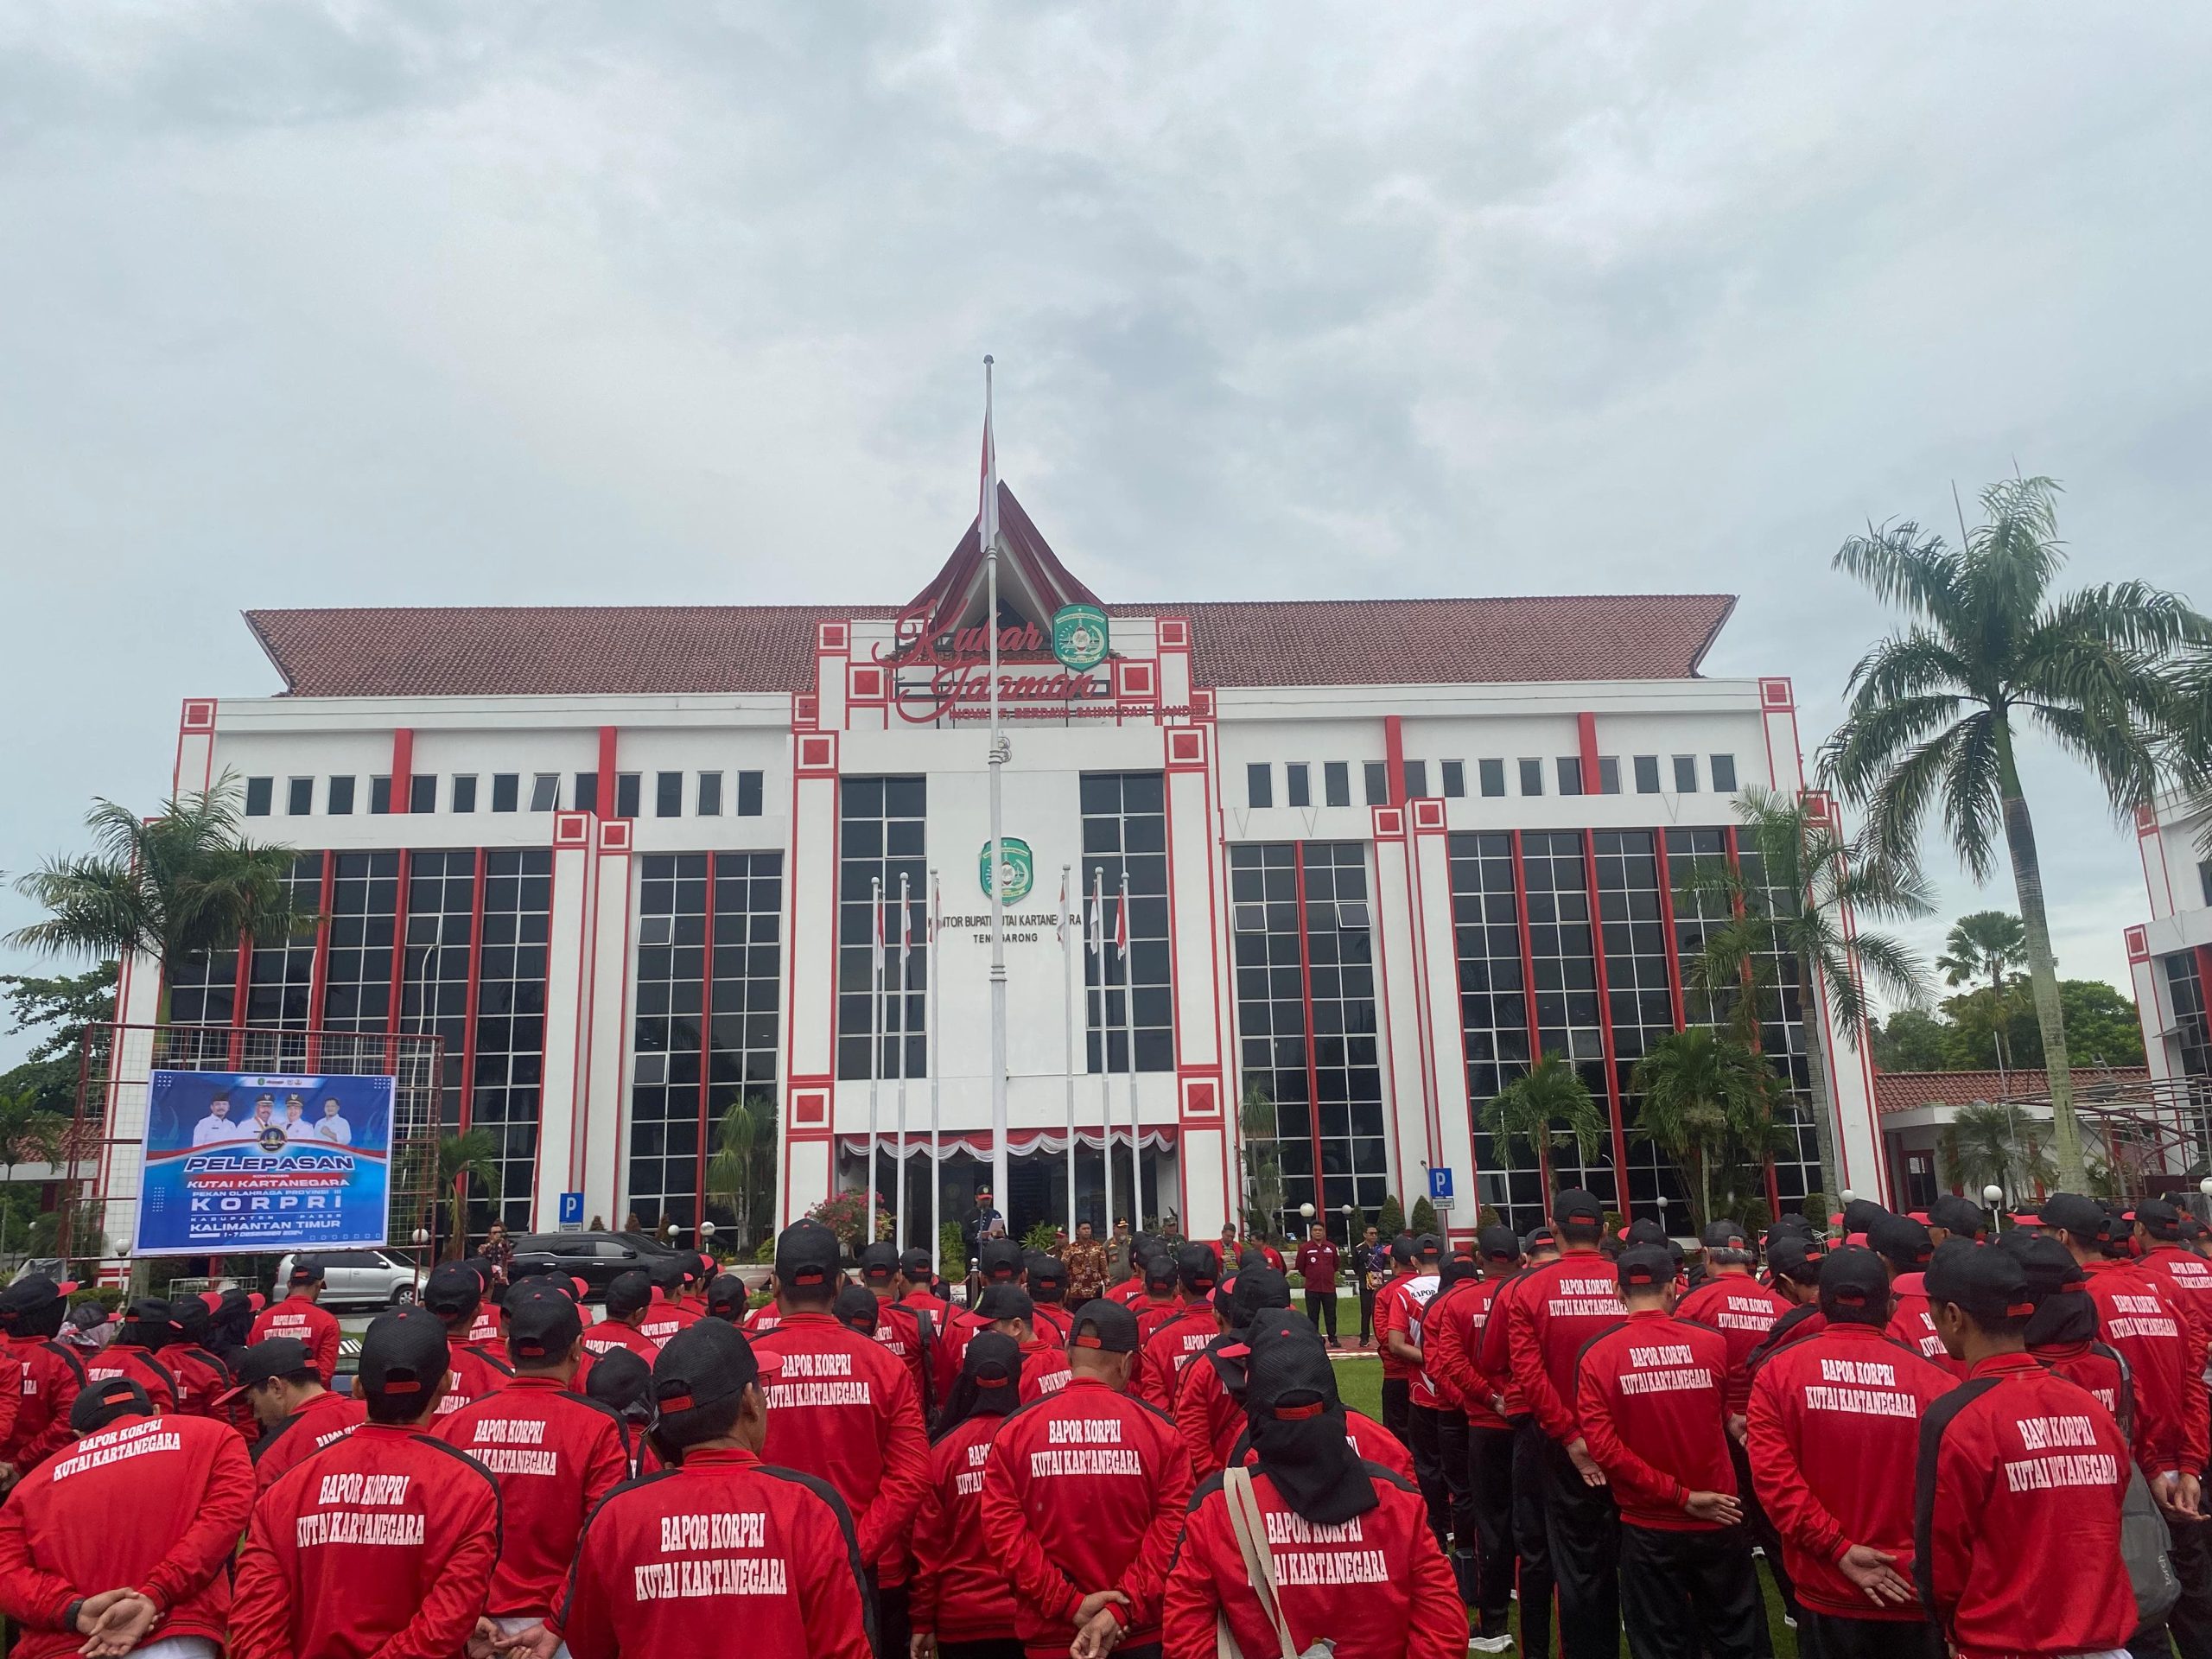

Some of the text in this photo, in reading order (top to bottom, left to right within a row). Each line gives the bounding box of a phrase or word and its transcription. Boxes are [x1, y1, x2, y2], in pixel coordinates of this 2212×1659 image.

[928, 915, 963, 928] KNTOR
[1020, 914, 1082, 925] KARTANERA
[973, 933, 1038, 944] TENARONG
[184, 1156, 355, 1172] PELEPASAN
[238, 1179, 351, 1187] KARTANEGARA
[1435, 1172, 1446, 1192] P
[191, 1195, 341, 1211] KORPRI
[566, 1197, 576, 1217] P
[190, 1220, 340, 1232] KALIMANTAN TIMUR
[1560, 1279, 1614, 1295] BAPOR KORPRI
[1548, 1300, 1573, 1316] KUTAI
[1727, 1296, 1774, 1314] BAPOR KORPRI
[1718, 1313, 1739, 1328] KUTAI
[2108, 1317, 2137, 1339] KUTAI
[1183, 1334, 1205, 1351] BAPOR
[781, 1354, 851, 1377] BAPOR KORPRI
[1630, 1345, 1694, 1368] BAPOR KORPRI
[1619, 1369, 1713, 1395] KUTAI KARTANEGARA
[1821, 1359, 1896, 1387] BAPOR KORPRI
[763, 1382, 871, 1409] KUTAI KARTANEGARA
[1805, 1386, 1916, 1419] KUTAI KARTANEGARA
[78, 1419, 162, 1452] BAPOR KORPRI
[474, 1420, 546, 1444] BAPOR KORPRI
[1048, 1419, 1121, 1443] BAPOR KORPRI
[2049, 1416, 2096, 1447] KORPRI
[54, 1433, 181, 1482] KUTAI KARTANEGARA
[483, 1449, 556, 1476] KARTANEGARA
[1031, 1449, 1141, 1478] KUTAI KARTANEGARA
[956, 1471, 982, 1495] KUTAI
[2005, 1458, 2052, 1492] KUTAI
[319, 1472, 410, 1505] BAPOR KORPRI
[297, 1512, 425, 1548] KUTAI KARTANEGARA
[661, 1513, 766, 1552] BAPOR KORPRI
[1265, 1512, 1311, 1544] BAPOR
[634, 1558, 787, 1601] KUTAI KARTANEGARA
[1289, 1550, 1389, 1585] KARTANEGARA
